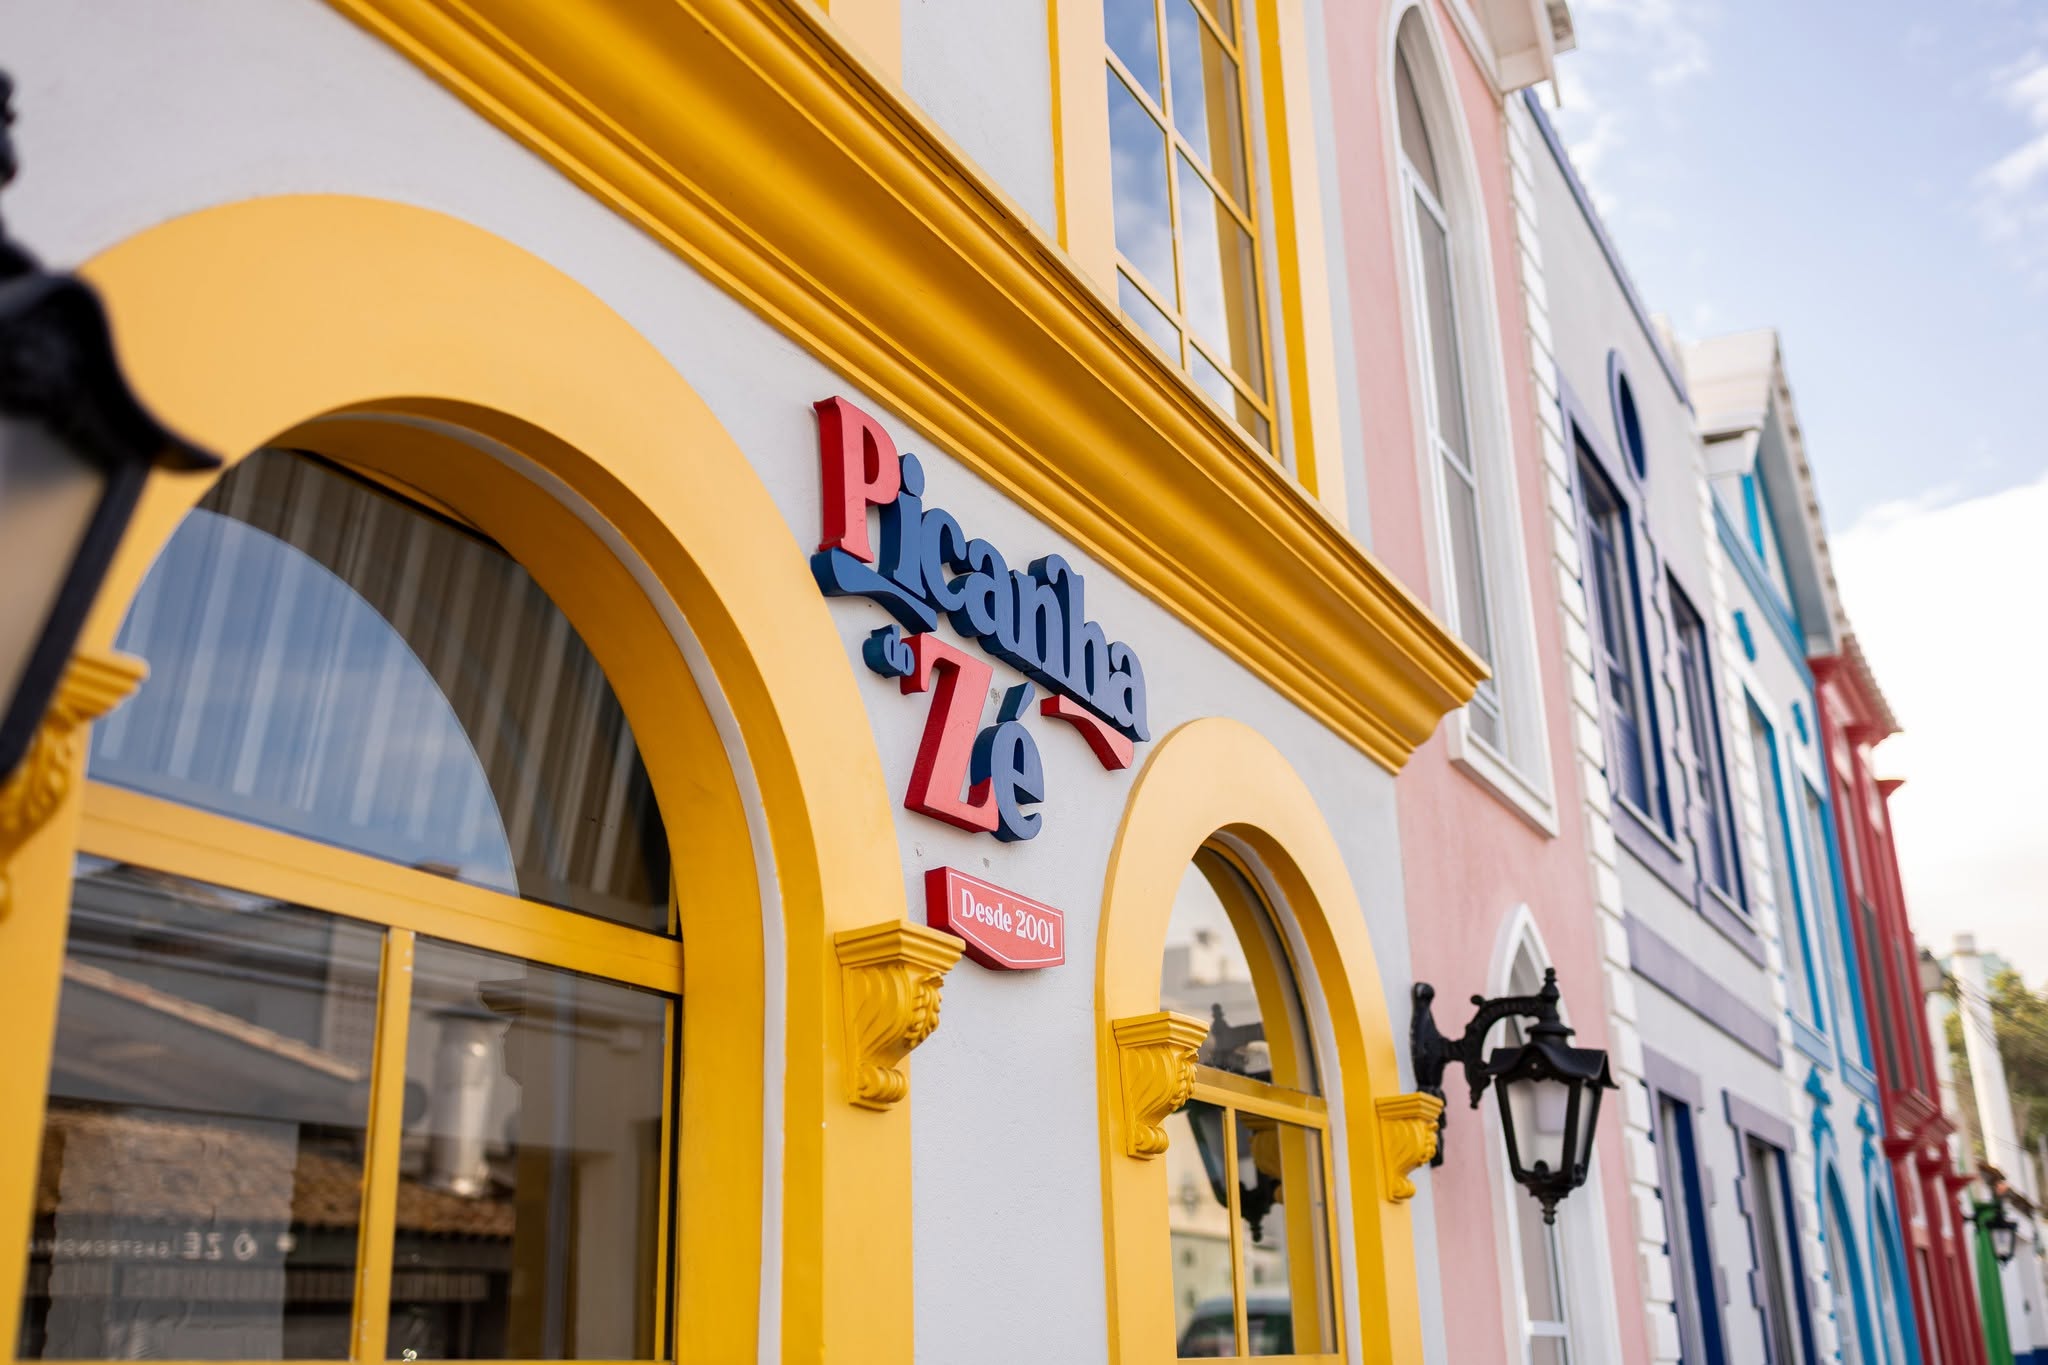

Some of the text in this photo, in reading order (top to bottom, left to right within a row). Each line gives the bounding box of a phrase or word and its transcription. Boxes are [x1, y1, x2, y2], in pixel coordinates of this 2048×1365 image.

[813, 396, 1150, 742] Picanha
[862, 624, 1044, 842] do Zé
[961, 888, 1056, 949] Desde 2001
